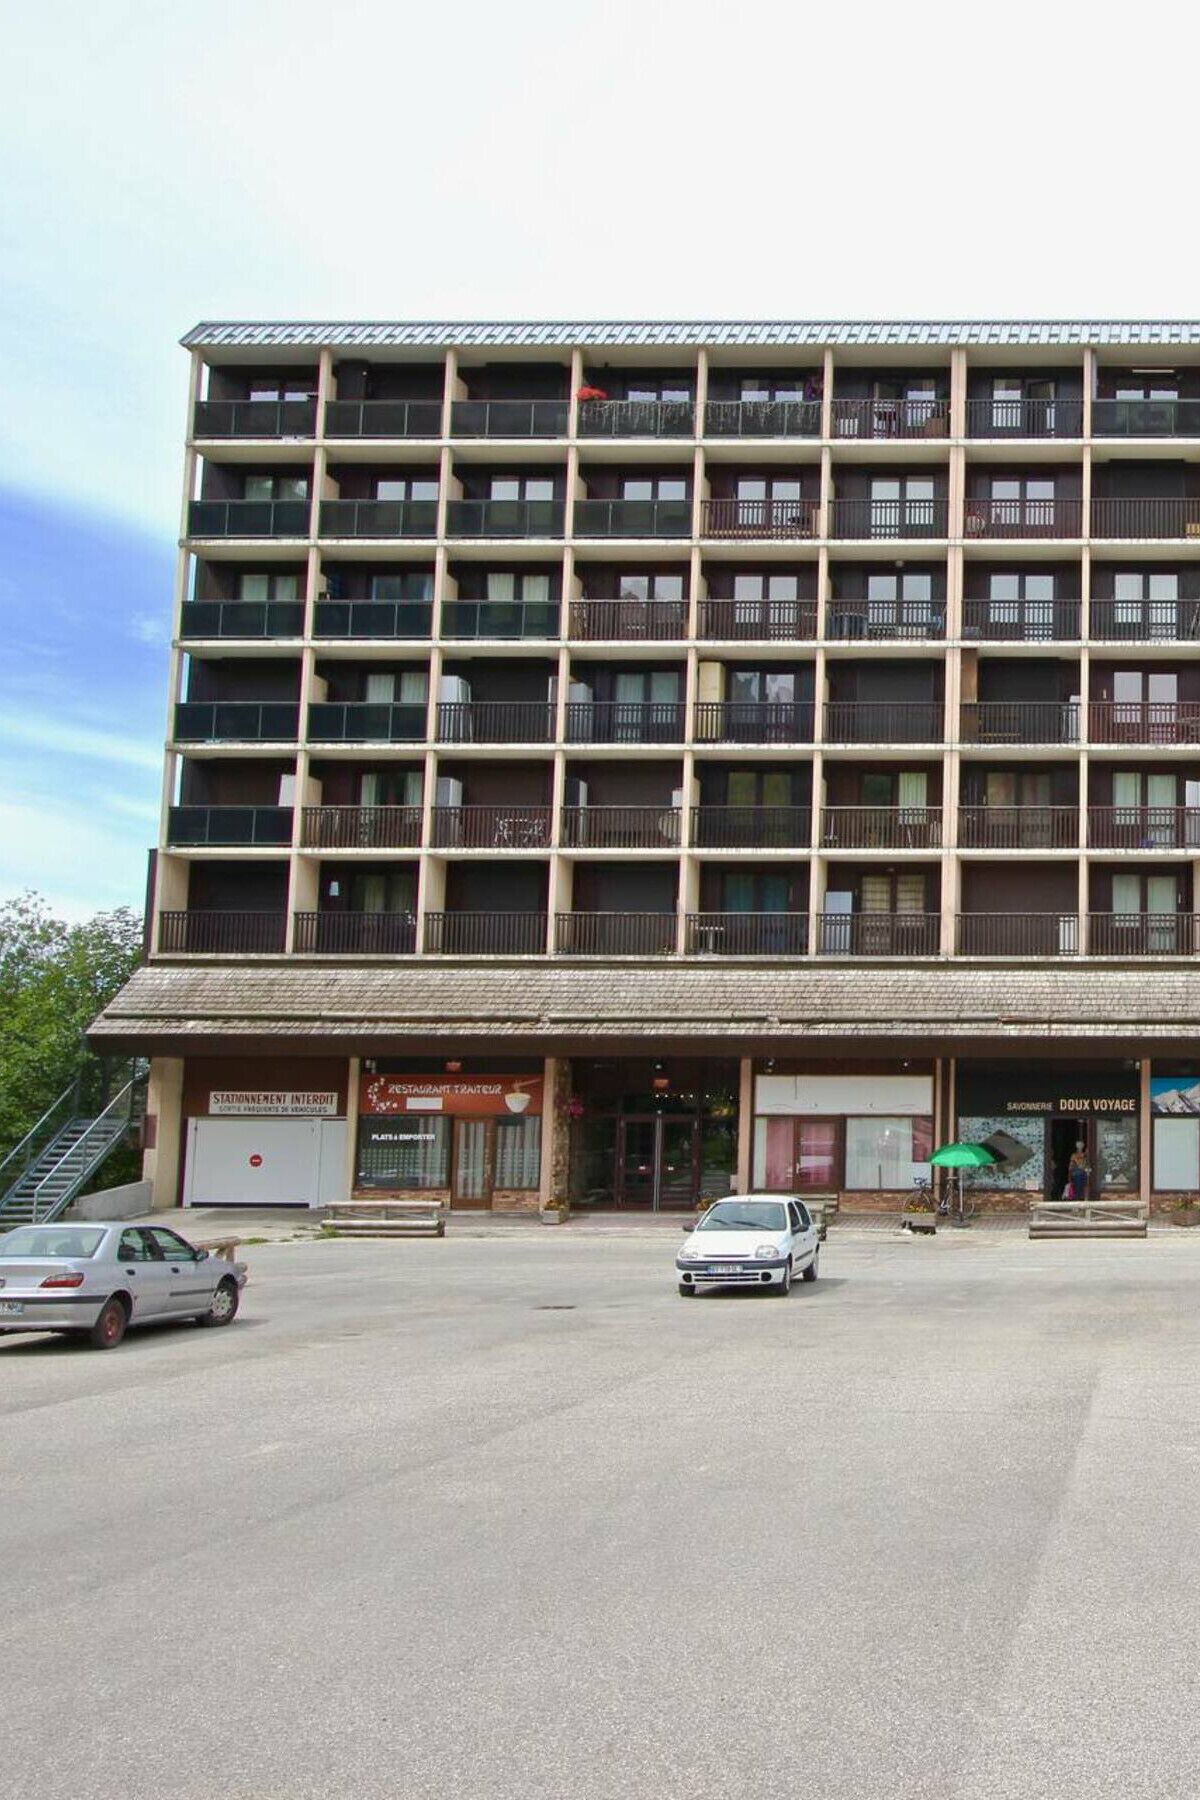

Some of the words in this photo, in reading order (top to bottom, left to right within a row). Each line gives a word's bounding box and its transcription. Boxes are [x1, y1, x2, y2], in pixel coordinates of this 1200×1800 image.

[388, 1084, 450, 1094] RESTAURANT
[454, 1084, 502, 1094] TRAITEUR
[213, 1093, 287, 1105] STATIONNEMENT
[291, 1093, 335, 1105] INTERDIT
[1006, 1101, 1053, 1111] SAVONNERIE
[1059, 1099, 1091, 1111] DOUX
[1092, 1099, 1136, 1111] VOYAGE
